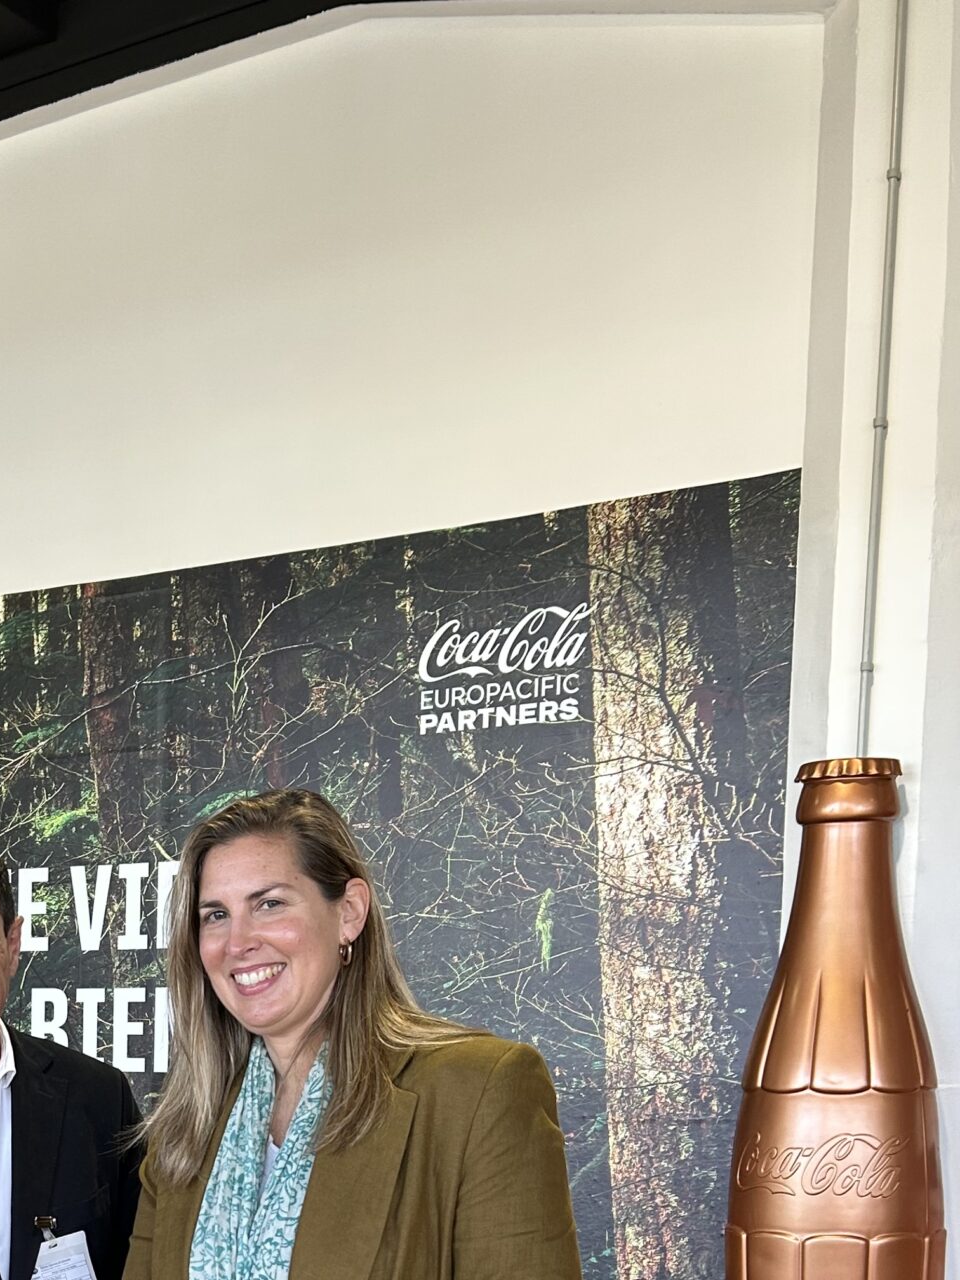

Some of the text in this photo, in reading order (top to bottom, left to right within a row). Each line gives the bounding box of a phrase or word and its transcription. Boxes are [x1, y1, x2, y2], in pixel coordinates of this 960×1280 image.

[418, 602, 600, 683] Coca-Cola
[419, 697, 579, 736] PARTNERS
[420, 673, 580, 711] EUROPACIFIC
[736, 1131, 909, 1199] Coca-Cola
